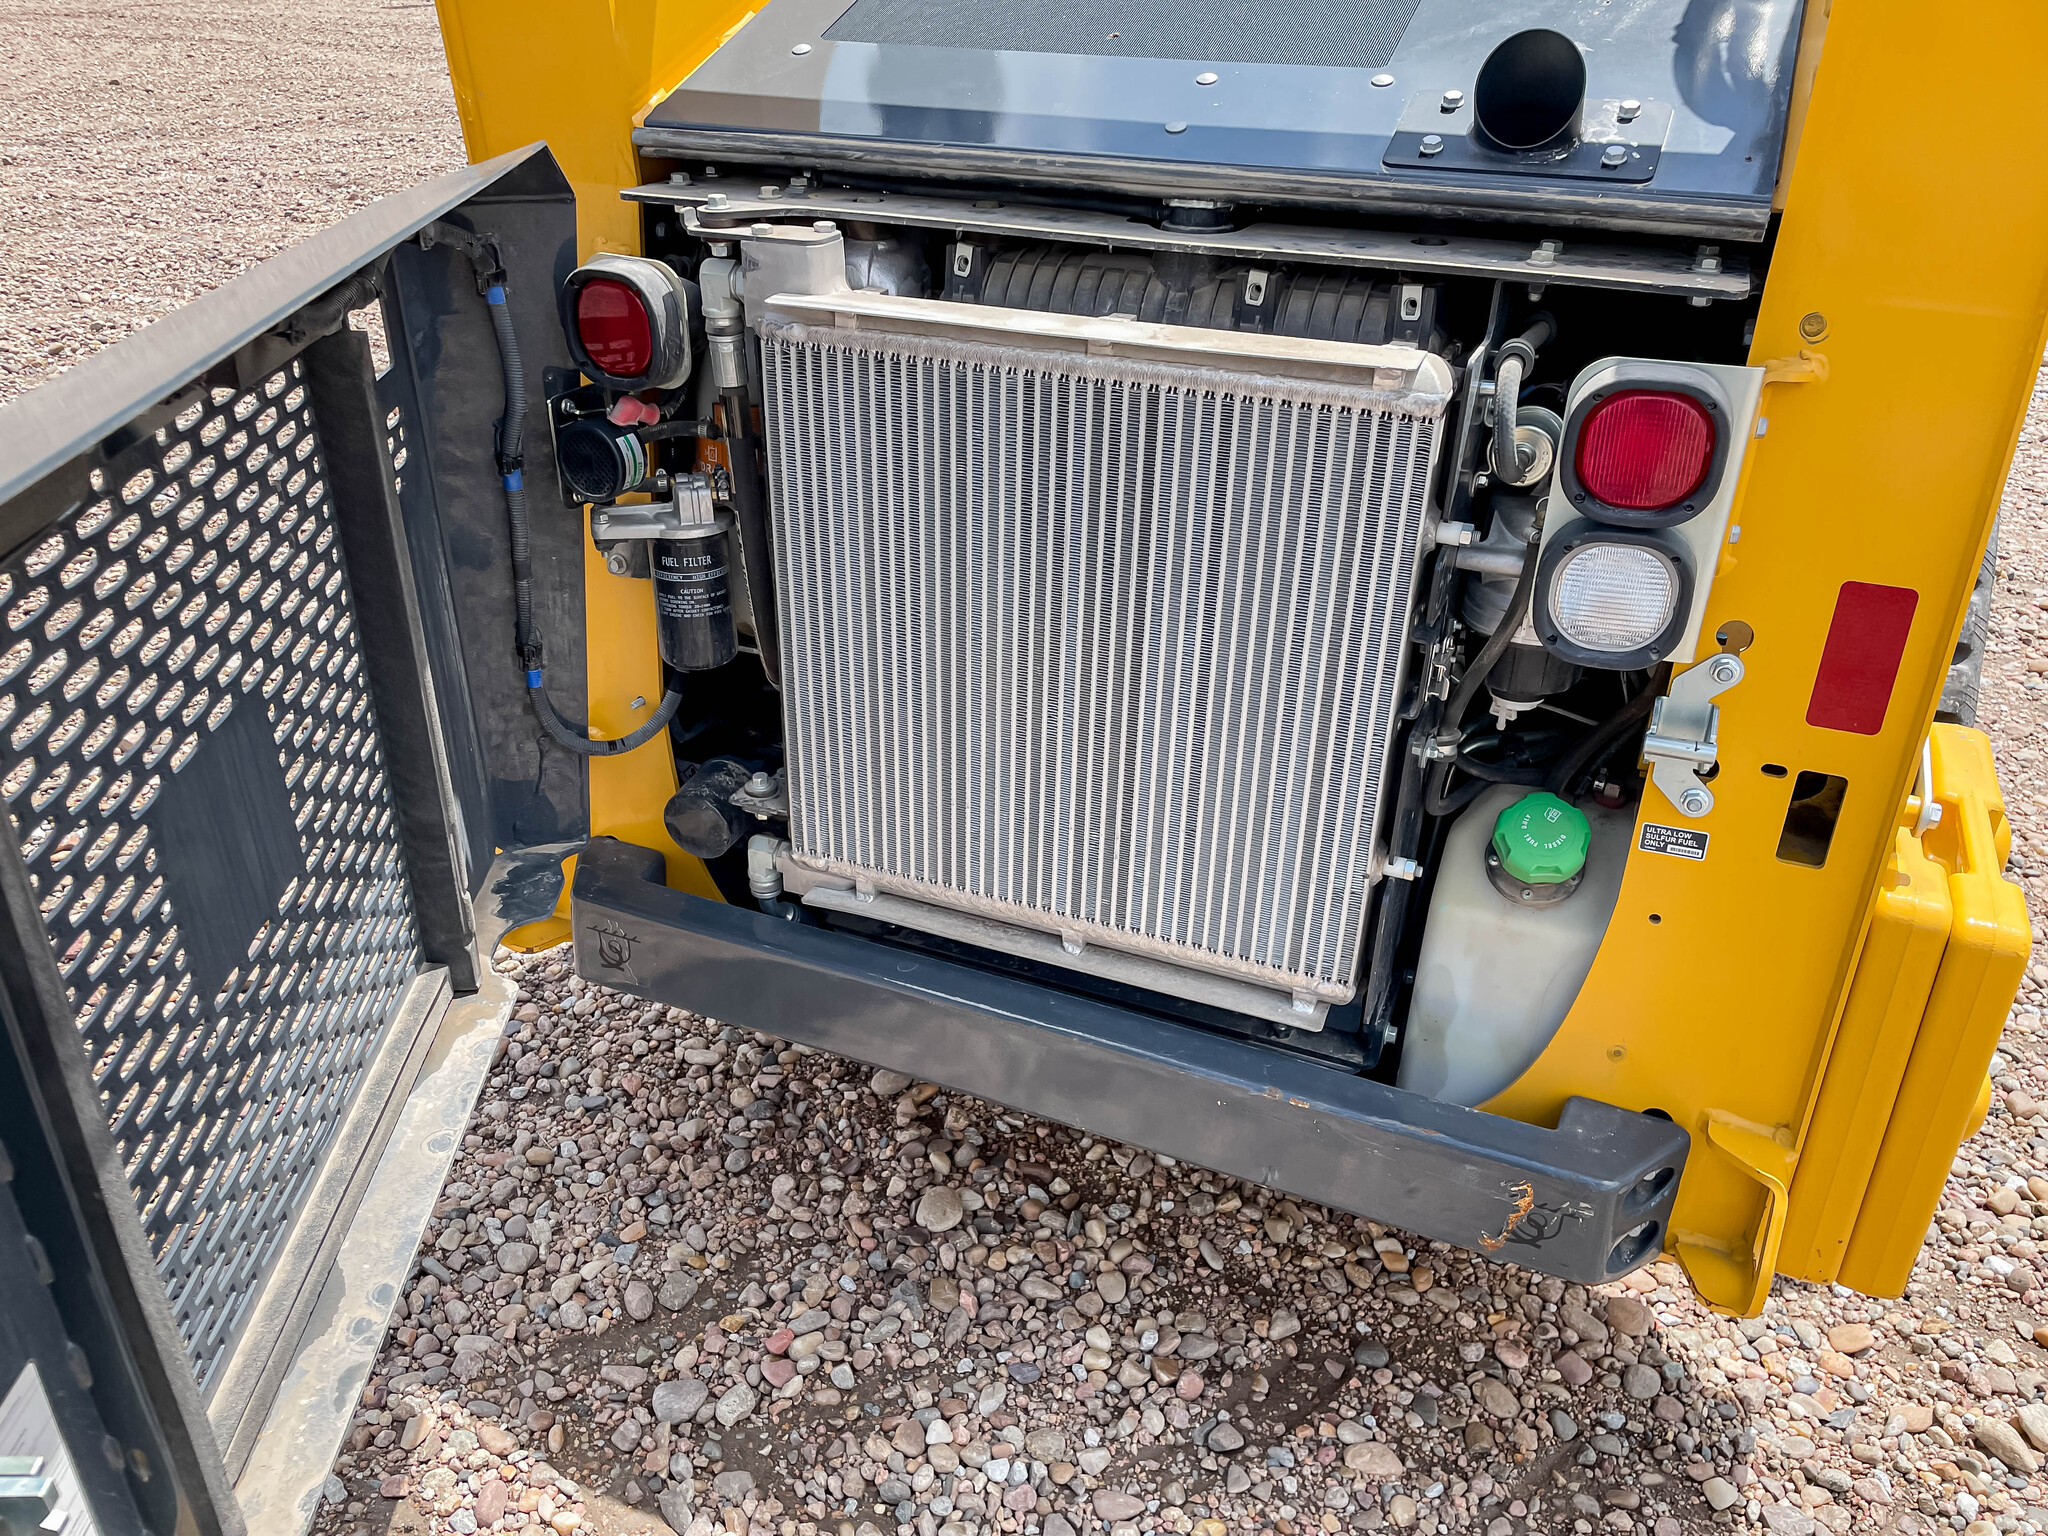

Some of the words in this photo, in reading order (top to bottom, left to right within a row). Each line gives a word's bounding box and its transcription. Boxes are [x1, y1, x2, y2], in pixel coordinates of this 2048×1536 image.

[662, 556, 679, 567] FUEL
[683, 555, 712, 567] FILTER
[1521, 814, 1531, 829] ONLY
[1523, 833, 1539, 847] FUEL
[1646, 826, 1672, 836] ULTRA
[1673, 831, 1693, 840] LOW
[1544, 834, 1567, 849] DIESEL
[1644, 839, 1665, 848] ONLY
[1645, 833, 1676, 844] SULFUR
[1677, 838, 1698, 848] FUEL
